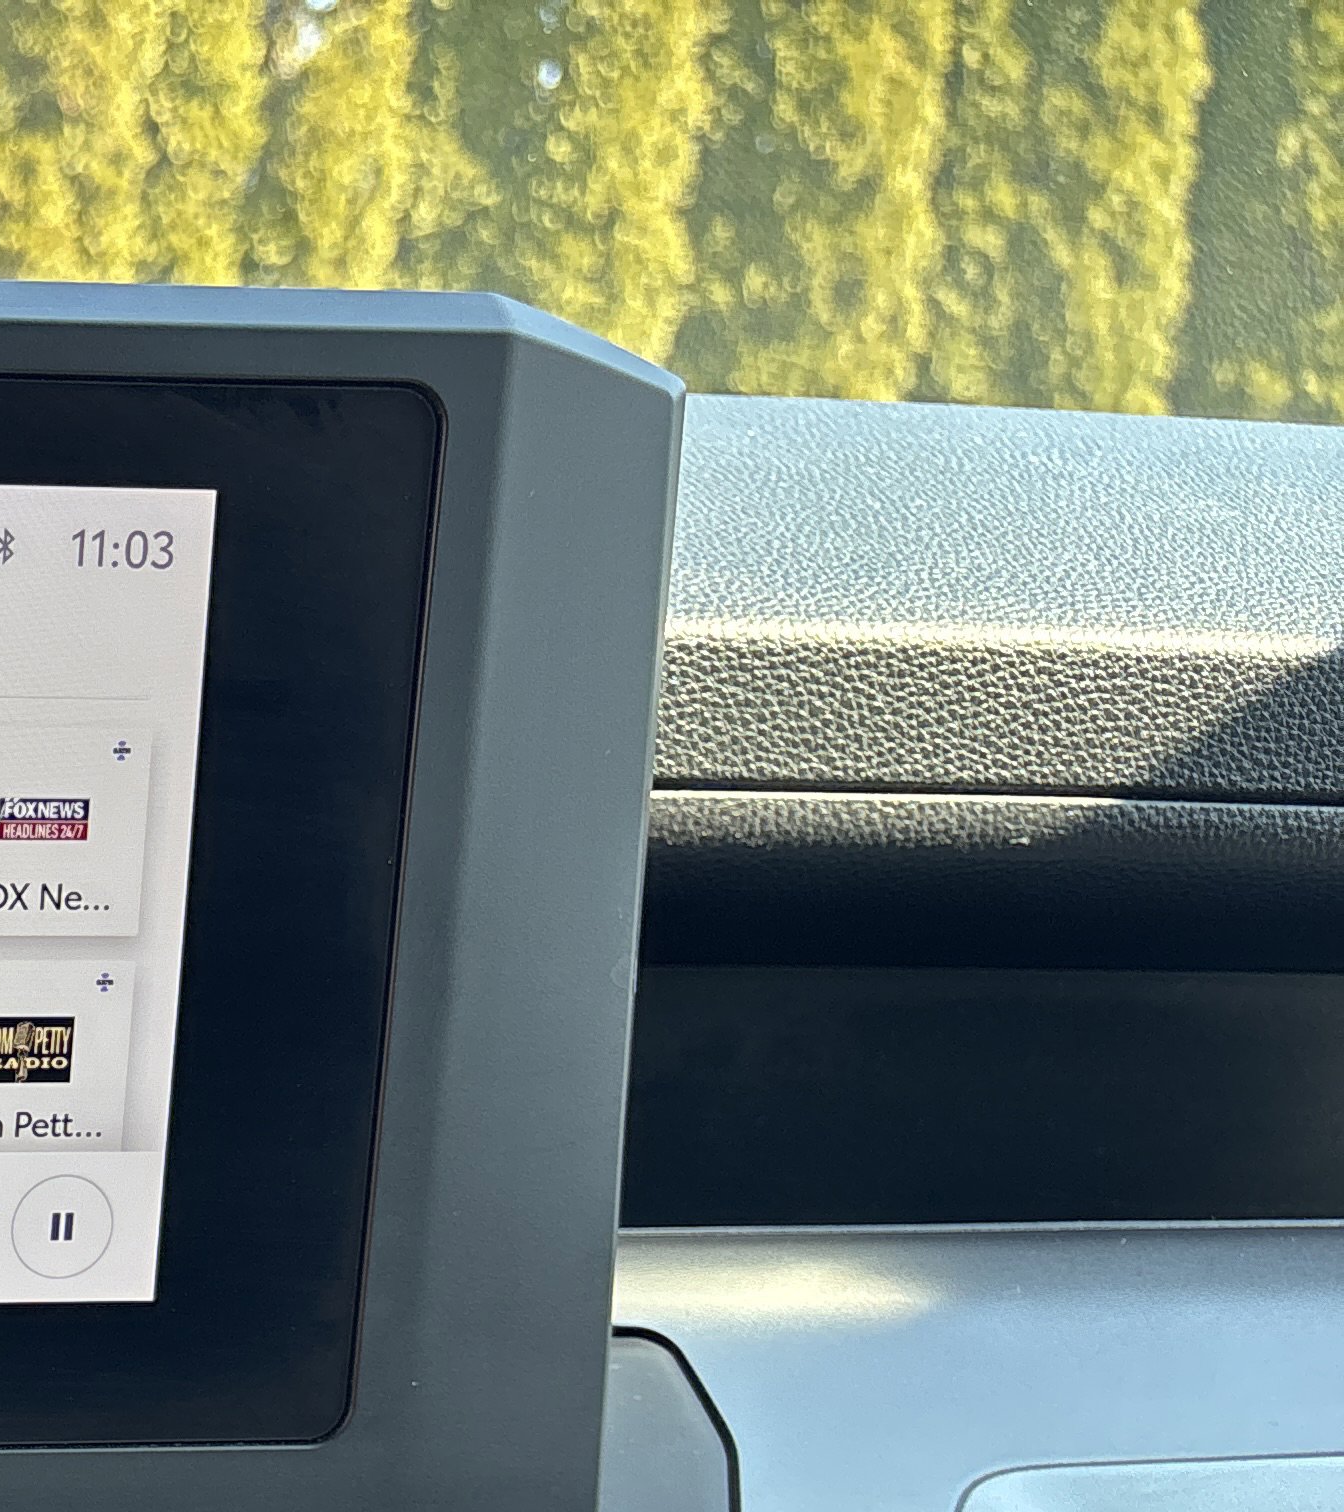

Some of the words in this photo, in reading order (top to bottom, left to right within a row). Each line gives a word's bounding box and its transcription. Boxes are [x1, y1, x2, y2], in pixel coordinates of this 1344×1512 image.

[71, 528, 175, 570] 11:03
[2, 823, 59, 839] HEADLINES
[39, 882, 110, 911] Ne...
[33, 1027, 72, 1055] PETTY
[14, 1111, 102, 1139] Pett...
